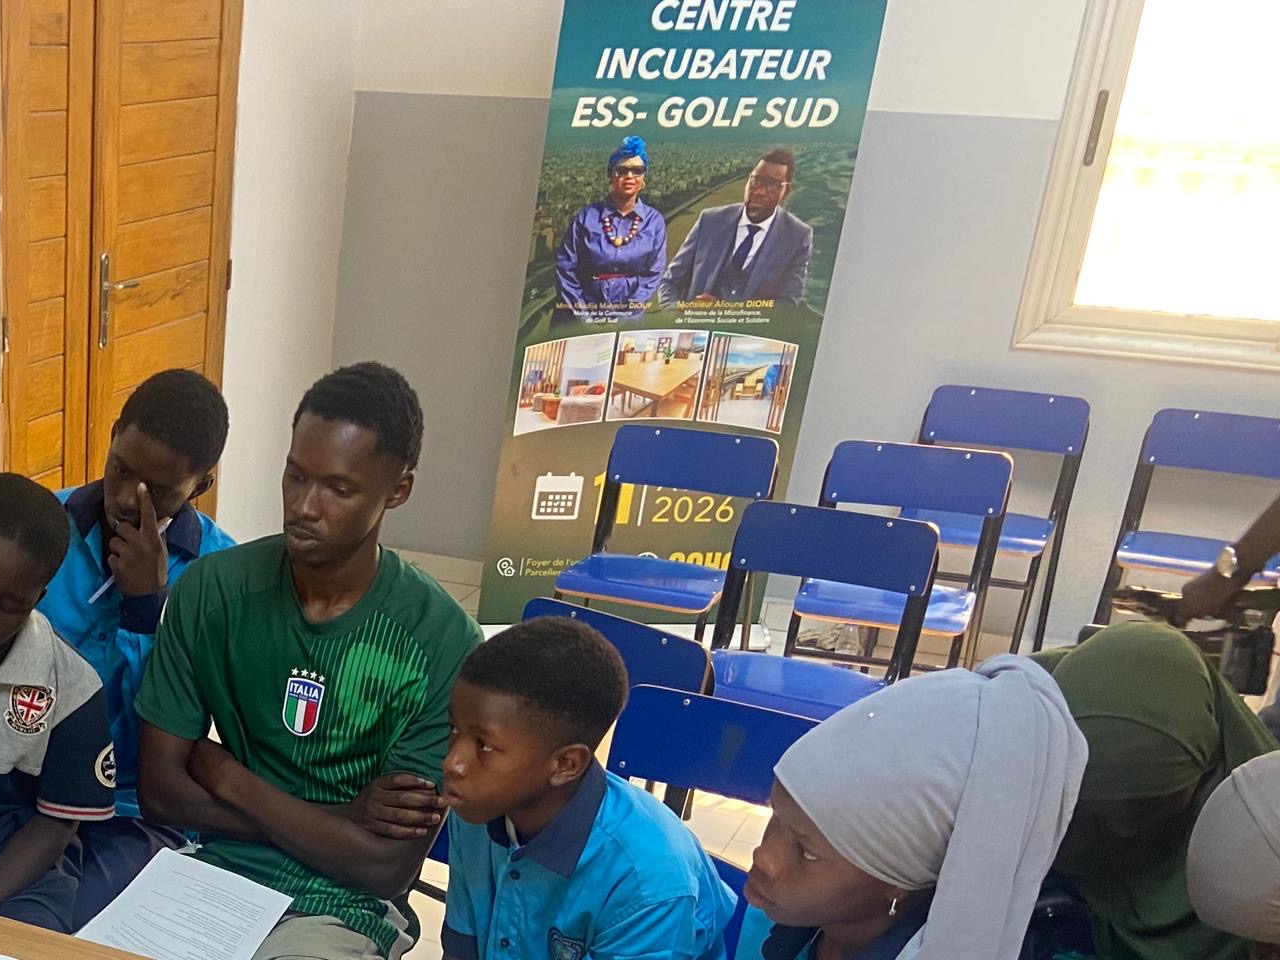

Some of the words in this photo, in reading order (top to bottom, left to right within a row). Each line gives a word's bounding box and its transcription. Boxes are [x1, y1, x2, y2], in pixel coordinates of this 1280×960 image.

[651, 0, 797, 31] CENTRE
[595, 47, 832, 81] INCUBATEUR
[571, 96, 648, 128] ESS-
[657, 96, 758, 128] GOLF
[760, 96, 839, 129] SUD
[628, 302, 653, 310] DIOUF
[745, 299, 775, 308] DIONE
[651, 495, 734, 523] 2026
[526, 558, 551, 568] Foyer
[552, 558, 564, 567] de
[289, 682, 319, 699] ITALIA
